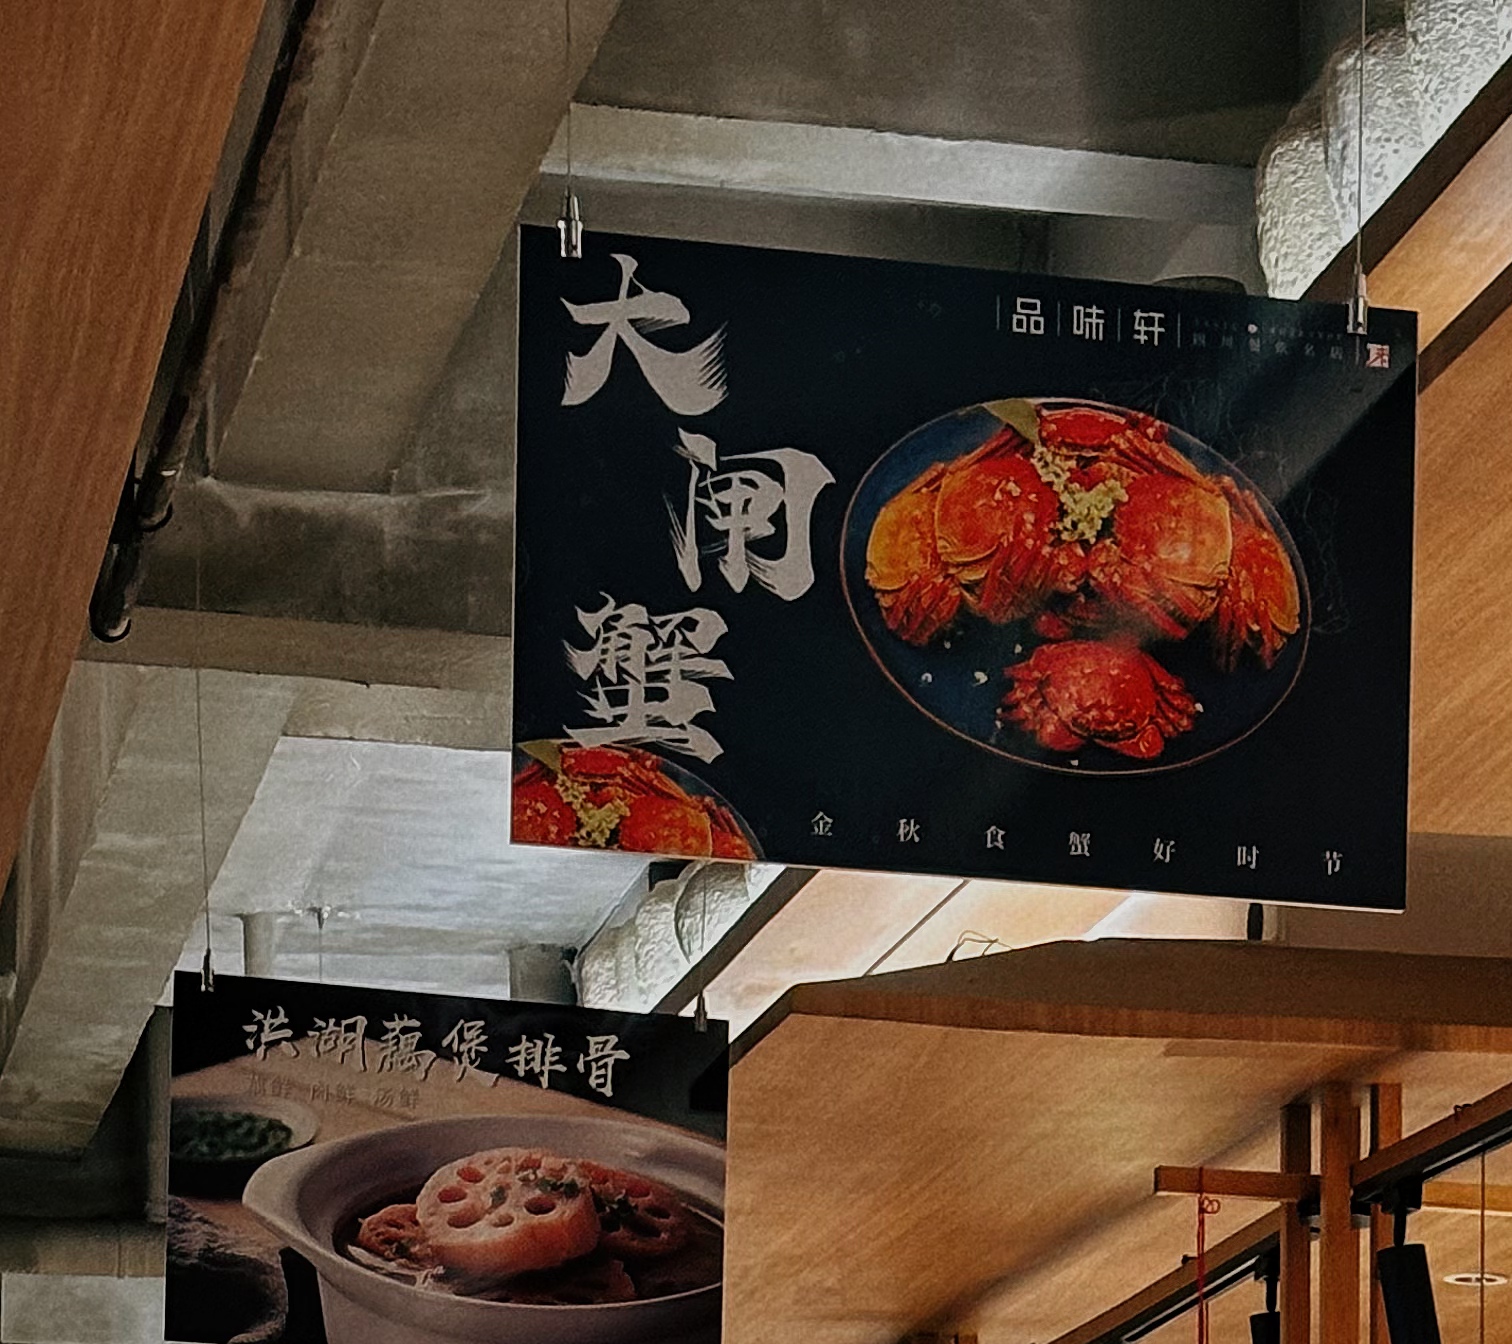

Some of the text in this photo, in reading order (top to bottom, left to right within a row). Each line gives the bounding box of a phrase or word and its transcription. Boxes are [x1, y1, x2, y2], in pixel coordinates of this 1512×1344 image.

[1012, 297, 1166, 347] 品味轩
[560, 253, 836, 765] 大闸蟹
[810, 811, 1344, 876] 金秋食蟹好时节
[242, 1005, 631, 1098] 洪湖藕煲排骨
